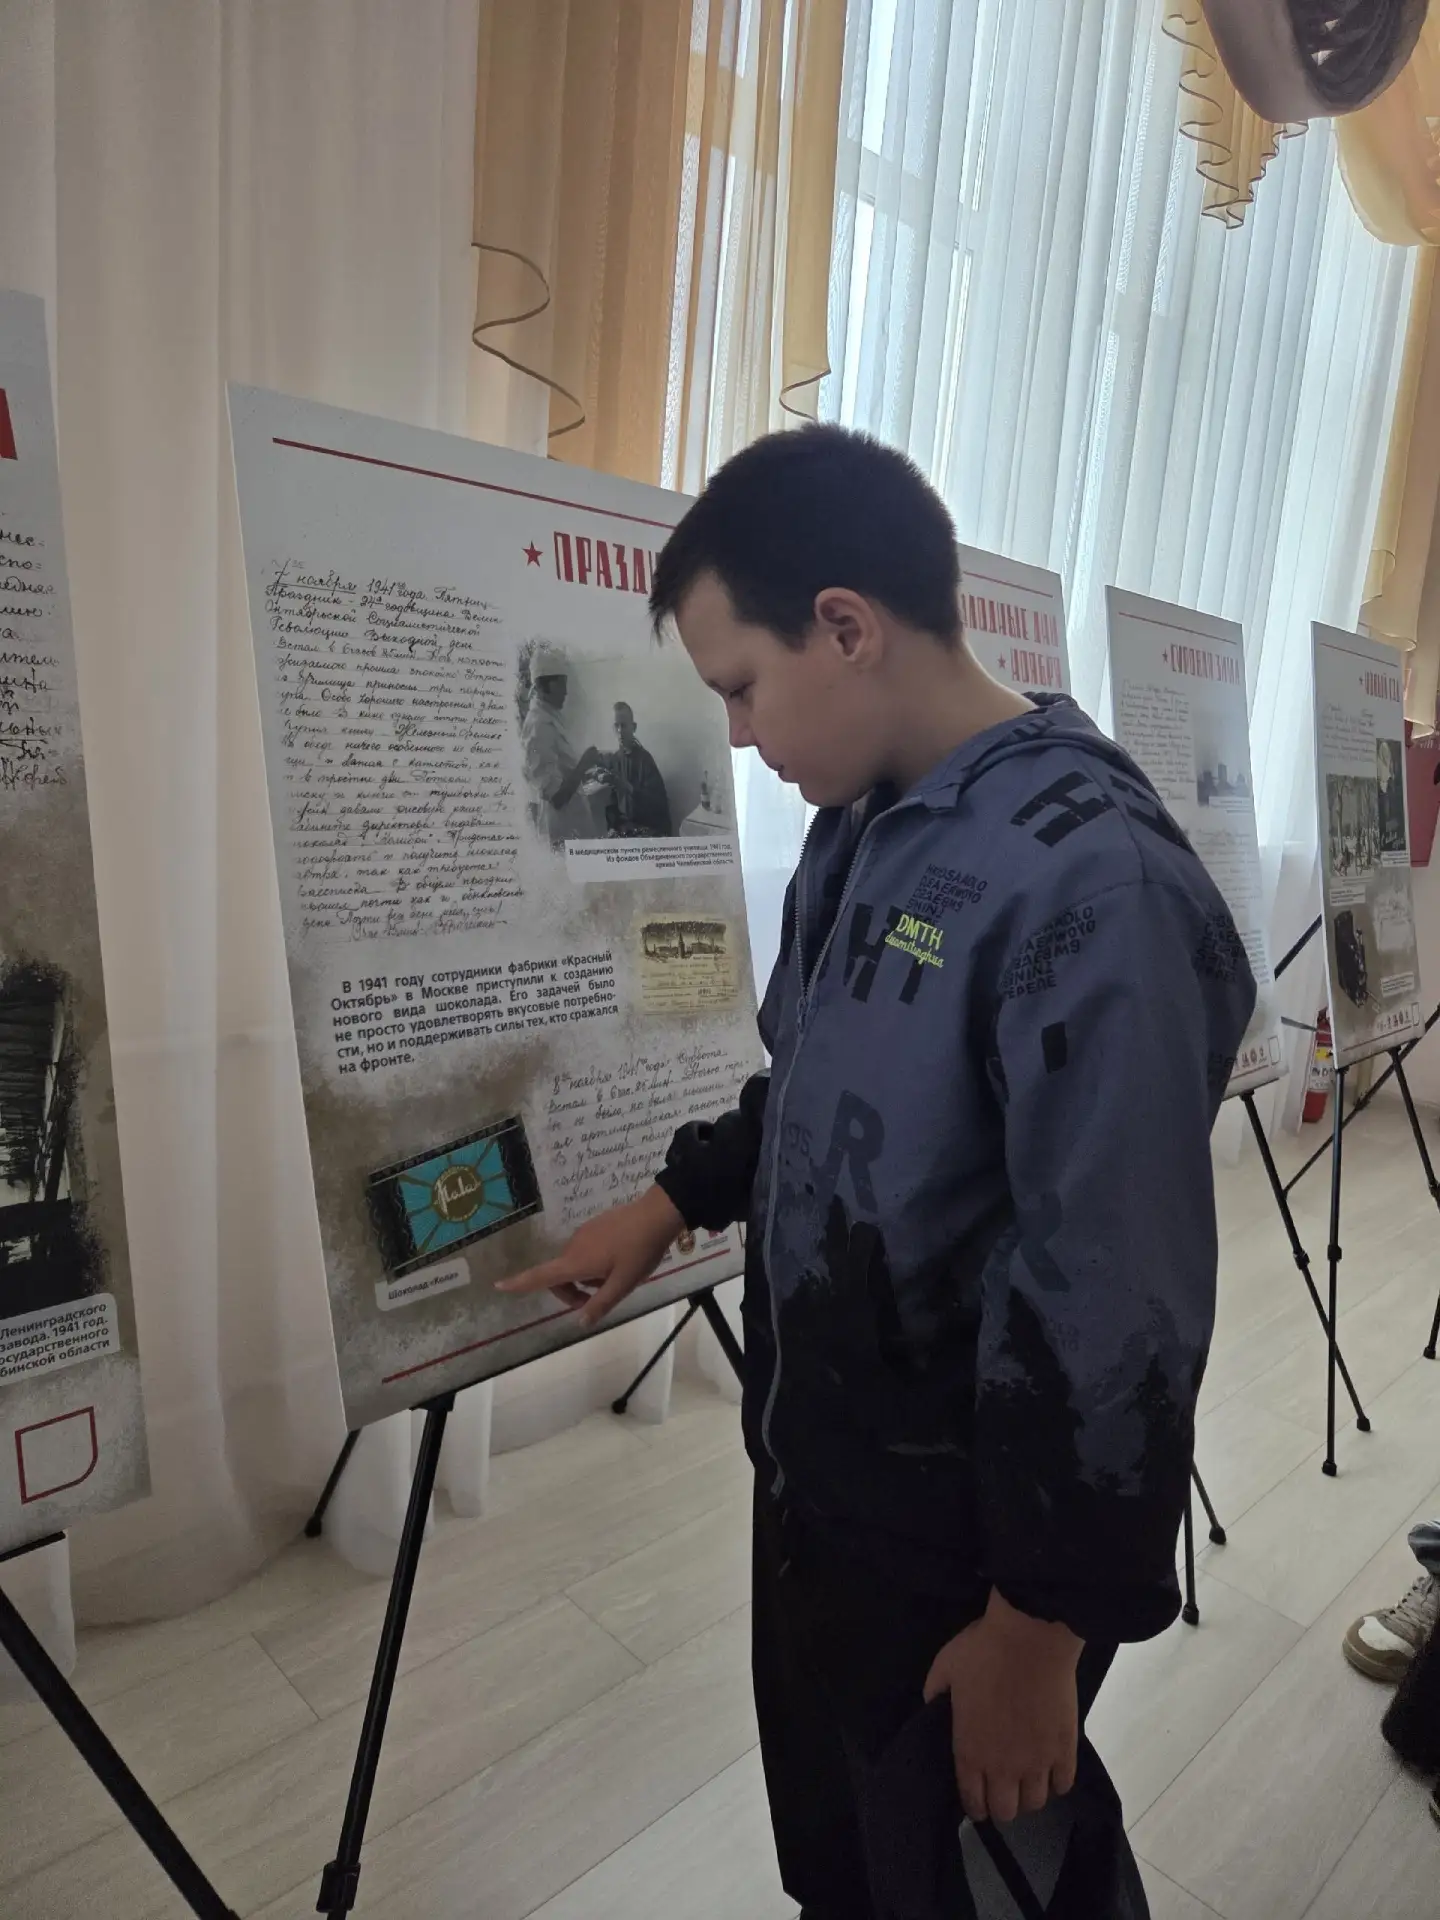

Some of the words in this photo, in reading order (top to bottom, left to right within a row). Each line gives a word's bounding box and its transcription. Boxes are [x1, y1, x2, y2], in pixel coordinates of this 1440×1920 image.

[896, 913, 944, 951] DMTH
[331, 993, 398, 1012] Октябрь»
[406, 992, 414, 1002] в
[421, 984, 469, 999] Москве
[476, 974, 544, 994] приступили
[550, 972, 558, 982] к
[564, 964, 615, 981] созданию
[342, 980, 352, 994] В
[358, 976, 388, 992] 1941
[395, 974, 425, 988] году
[431, 965, 503, 983] сотрудники
[508, 958, 557, 976] фабрики
[561, 948, 613, 967] «Красный
[332, 1010, 383, 1027] нового
[393, 1005, 426, 1019] вида
[436, 994, 502, 1013] шоколада.
[510, 989, 528, 1002] Его
[536, 981, 581, 999] задачей
[588, 978, 615, 991] было
[335, 1031, 352, 1043] не
[357, 1023, 405, 1040] просто
[409, 1008, 504, 1034] удовлетворять
[507, 999, 560, 1018] вкусовые
[563, 991, 616, 1010] потребно-
[337, 1045, 364, 1060] сти,
[367, 1041, 384, 1054] но
[387, 1040, 396, 1051] и
[399, 1024, 492, 1048] поддерживать
[494, 1018, 525, 1033] силы
[526, 1016, 548, 1028] тех,
[549, 1012, 568, 1024] кто
[569, 1003, 619, 1022] сражался
[339, 1061, 357, 1075] на
[360, 1052, 415, 1073] фронте.
[387, 1281, 430, 1300] Шоколад
[0, 1303, 107, 1340] Ленинградского
[52, 1321, 79, 1337] 1941
[82, 1315, 109, 1330] год.
[58, 1339, 110, 1361] области
